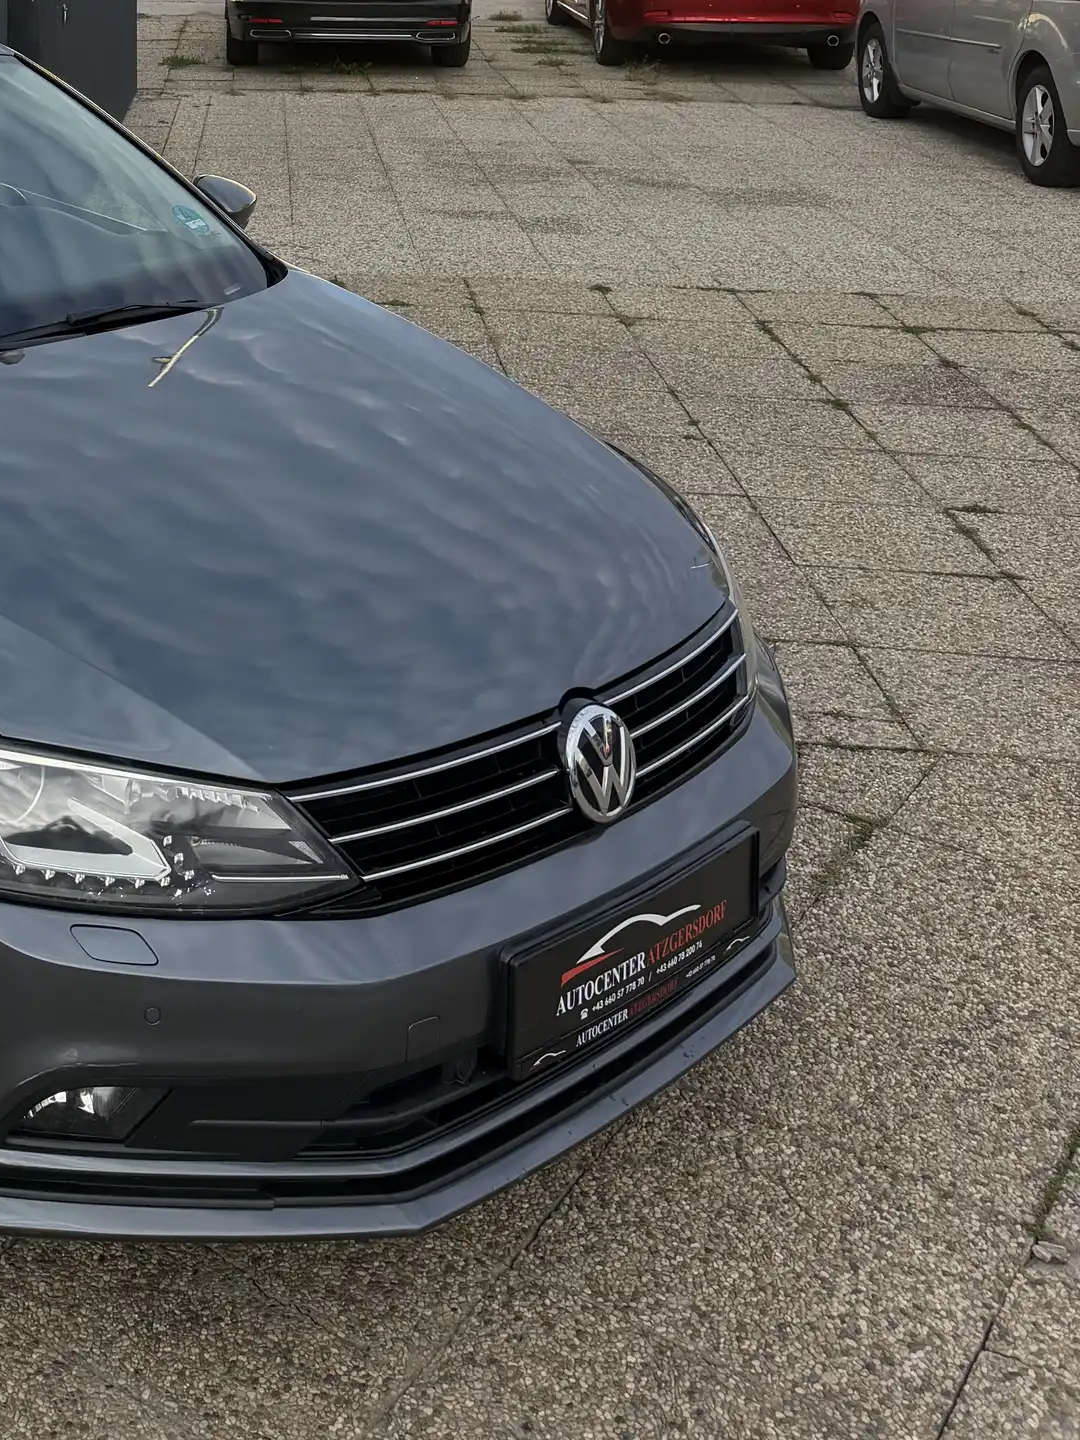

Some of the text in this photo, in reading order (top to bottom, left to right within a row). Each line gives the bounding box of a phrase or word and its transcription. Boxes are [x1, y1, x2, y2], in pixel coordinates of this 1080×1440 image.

[556, 899, 727, 1017] AUTOCENTER ATZGERSDORF
[592, 999, 604, 1012] +43
[604, 993, 617, 1007] 660
[617, 988, 624, 1000] 57
[625, 981, 637, 995] 778
[637, 976, 645, 987] 70
[656, 962, 667, 975] +43
[685, 945, 696, 958] 200
[575, 1008, 629, 1048] AUTOCENTER
